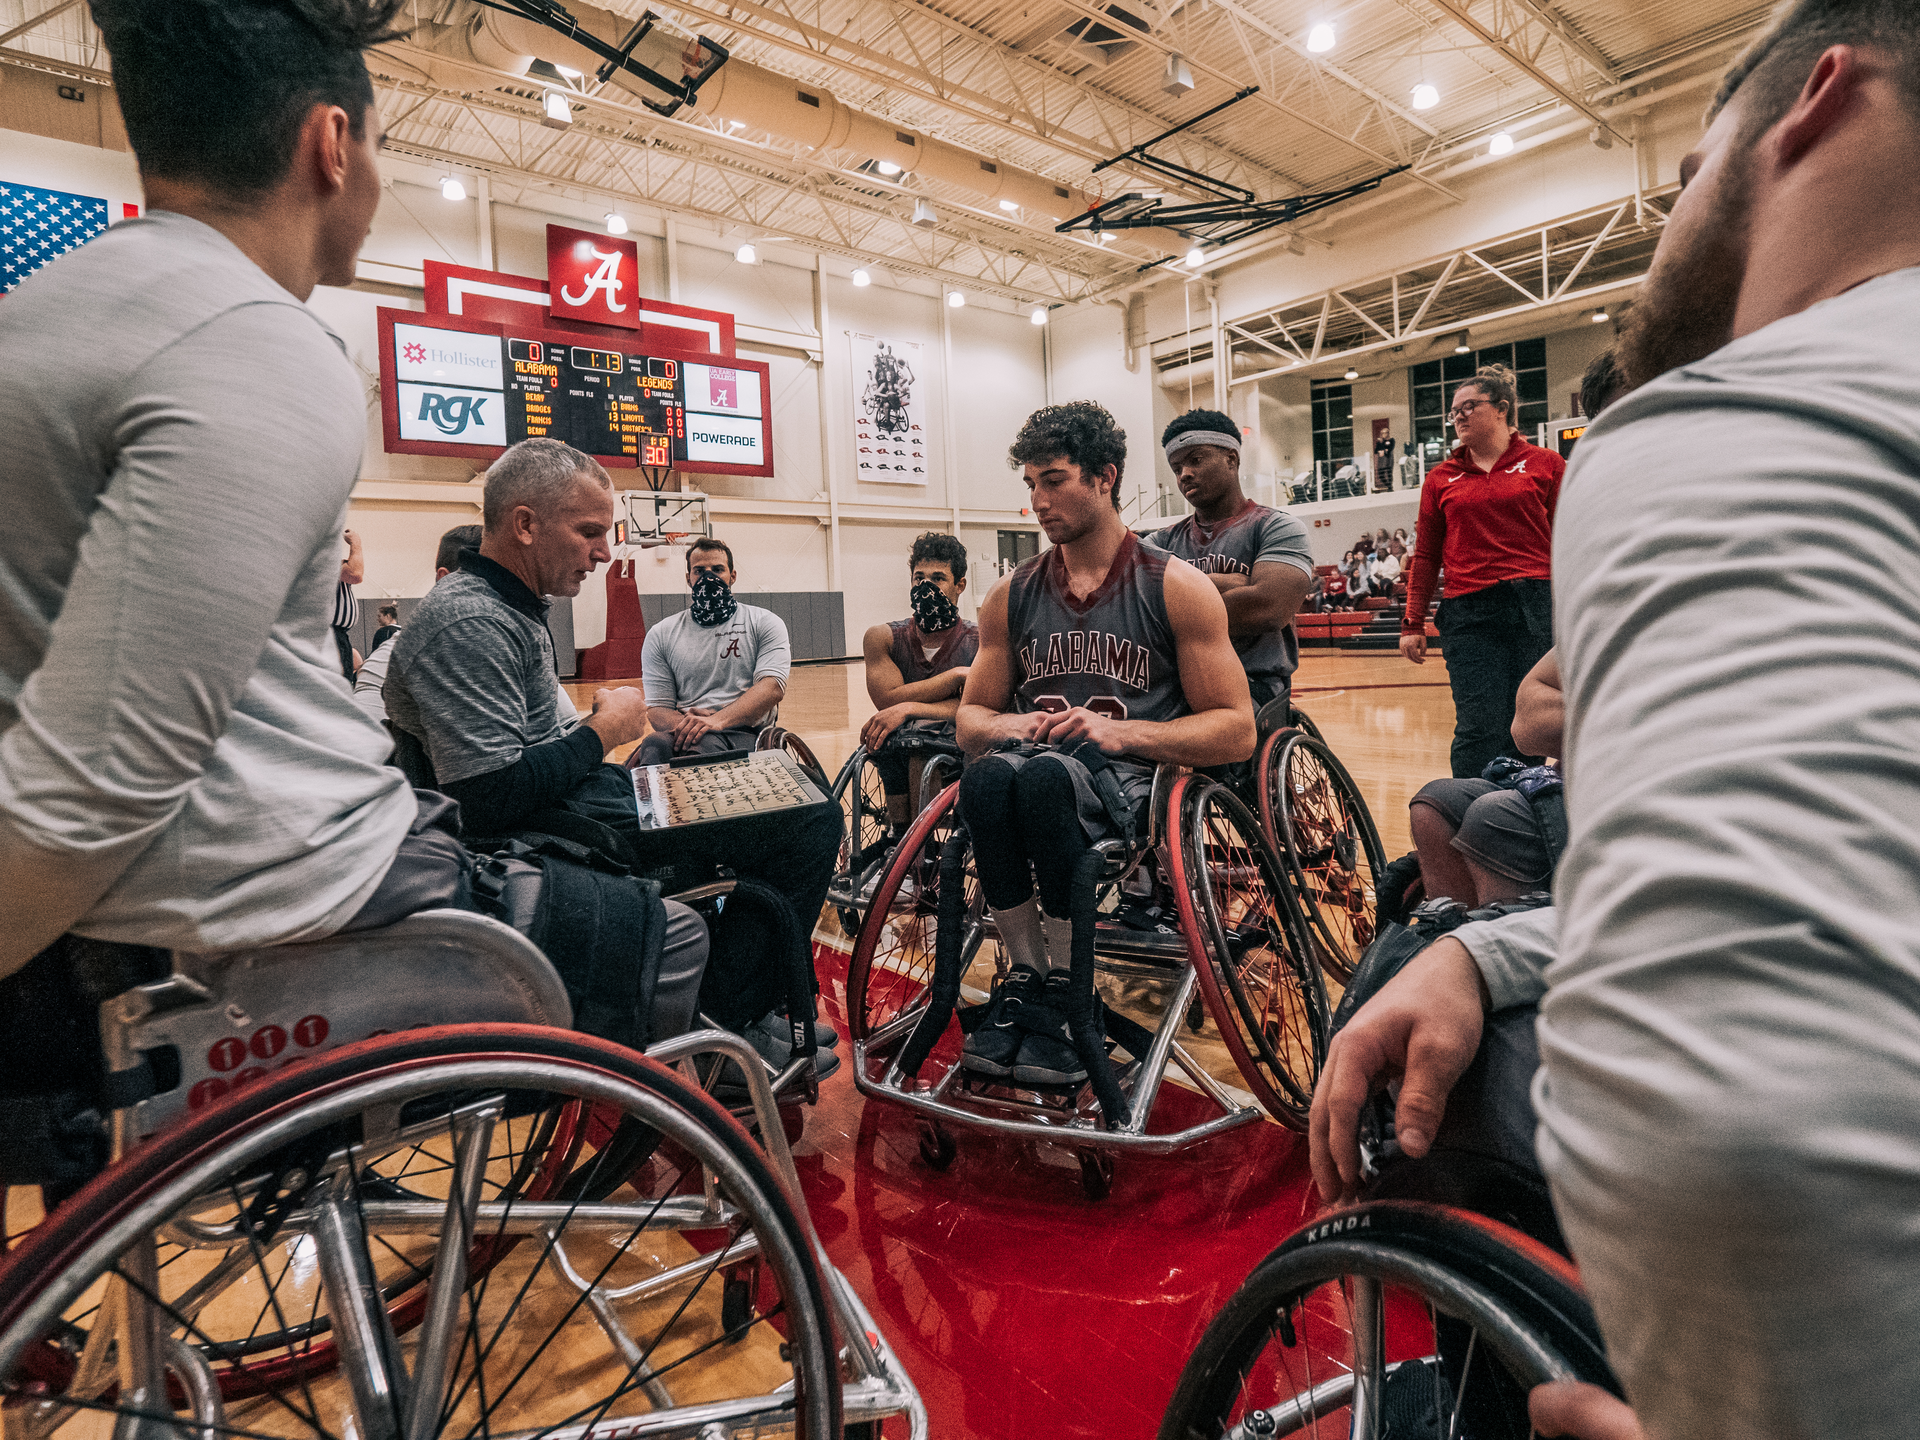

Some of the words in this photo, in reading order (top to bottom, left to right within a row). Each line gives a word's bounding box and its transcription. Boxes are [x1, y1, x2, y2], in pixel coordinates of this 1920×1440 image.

[561, 246, 626, 313] A
[529, 343, 540, 361] 0
[430, 349, 497, 369] Hollister
[591, 352, 621, 371] 1:13
[515, 361, 558, 377] ALABAMA
[665, 362, 675, 378] 0
[529, 376, 543, 384] FOULS
[551, 377, 558, 388] 0
[637, 376, 673, 391] LEGENDS
[710, 374, 735, 382] COLLEGE
[524, 384, 541, 392] PLAYER
[569, 389, 585, 397] POINTS
[644, 388, 651, 398] 0
[619, 394, 635, 402] PLAYER
[526, 403, 552, 414] BRIDGES
[611, 401, 618, 411] 0
[608, 411, 619, 422] 13
[666, 407, 673, 416] 0
[676, 407, 683, 418] 0
[609, 423, 620, 432] 14
[666, 417, 674, 427] 0
[676, 418, 684, 428] 0
[677, 428, 684, 438] 0
[651, 436, 669, 448] 1:13
[692, 432, 756, 447] POWERADE
[646, 446, 666, 466] 30
[1505, 459, 1527, 474] A
[720, 638, 742, 660] A
[794, 1021, 805, 1049] TIGA
[1308, 1215, 1371, 1243] KENDA
